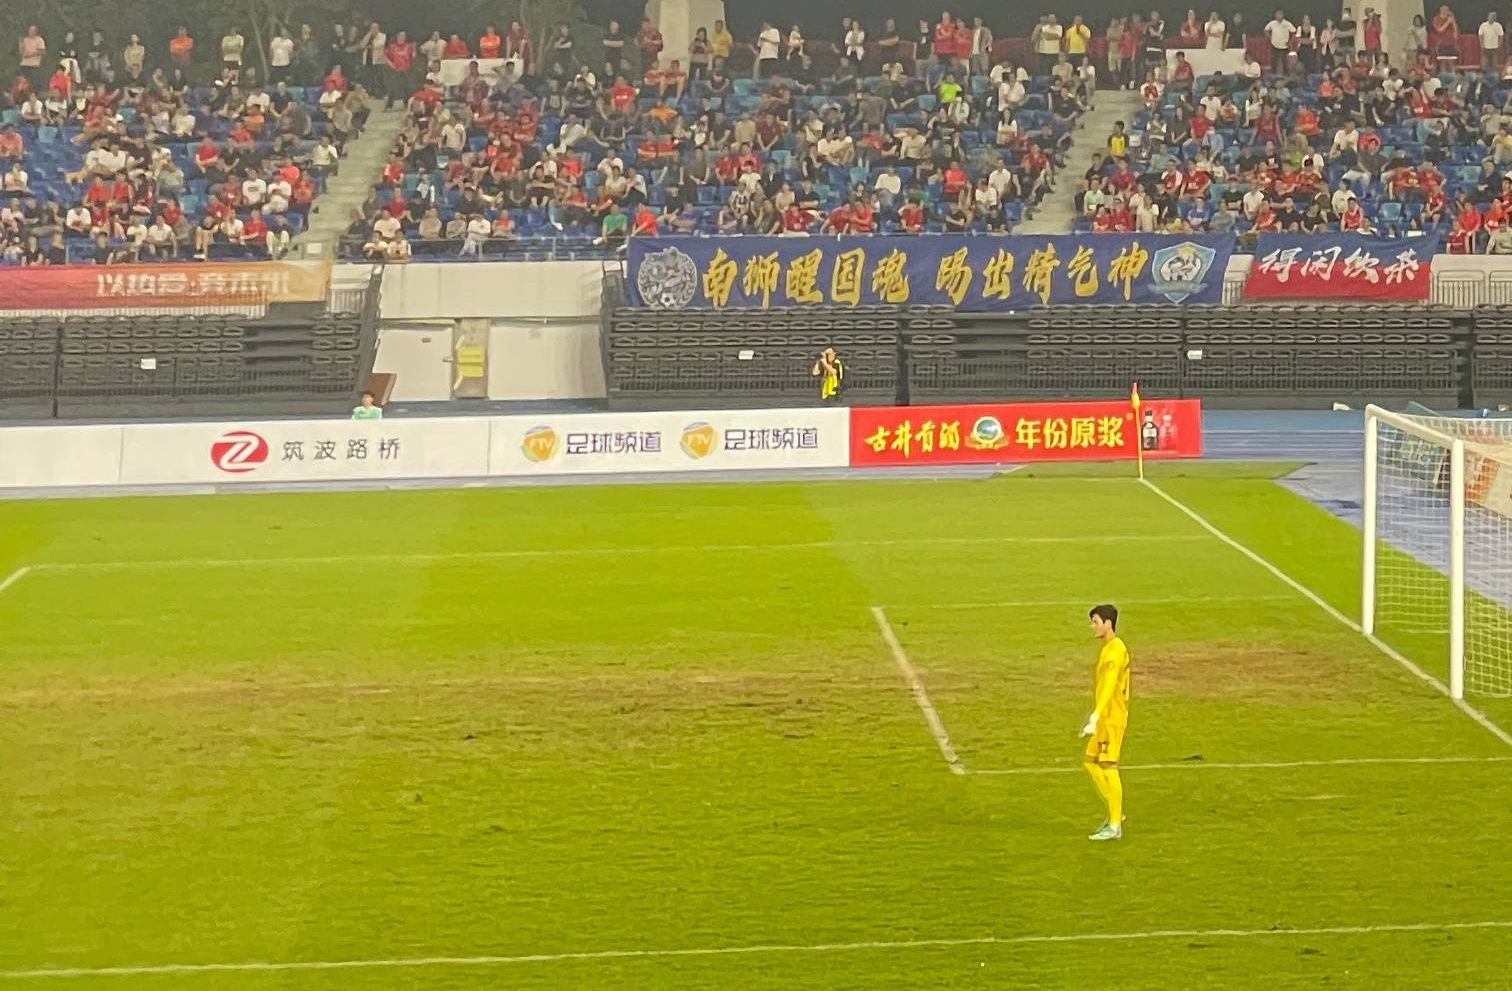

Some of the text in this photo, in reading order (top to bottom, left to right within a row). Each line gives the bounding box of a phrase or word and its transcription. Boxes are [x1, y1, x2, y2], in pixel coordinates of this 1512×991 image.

[566, 430, 662, 455] 足球频道
[724, 427, 818, 451] 足球频道
[1015, 416, 1125, 450] 年份原浆
[281, 437, 400, 462] 筑波路桥
